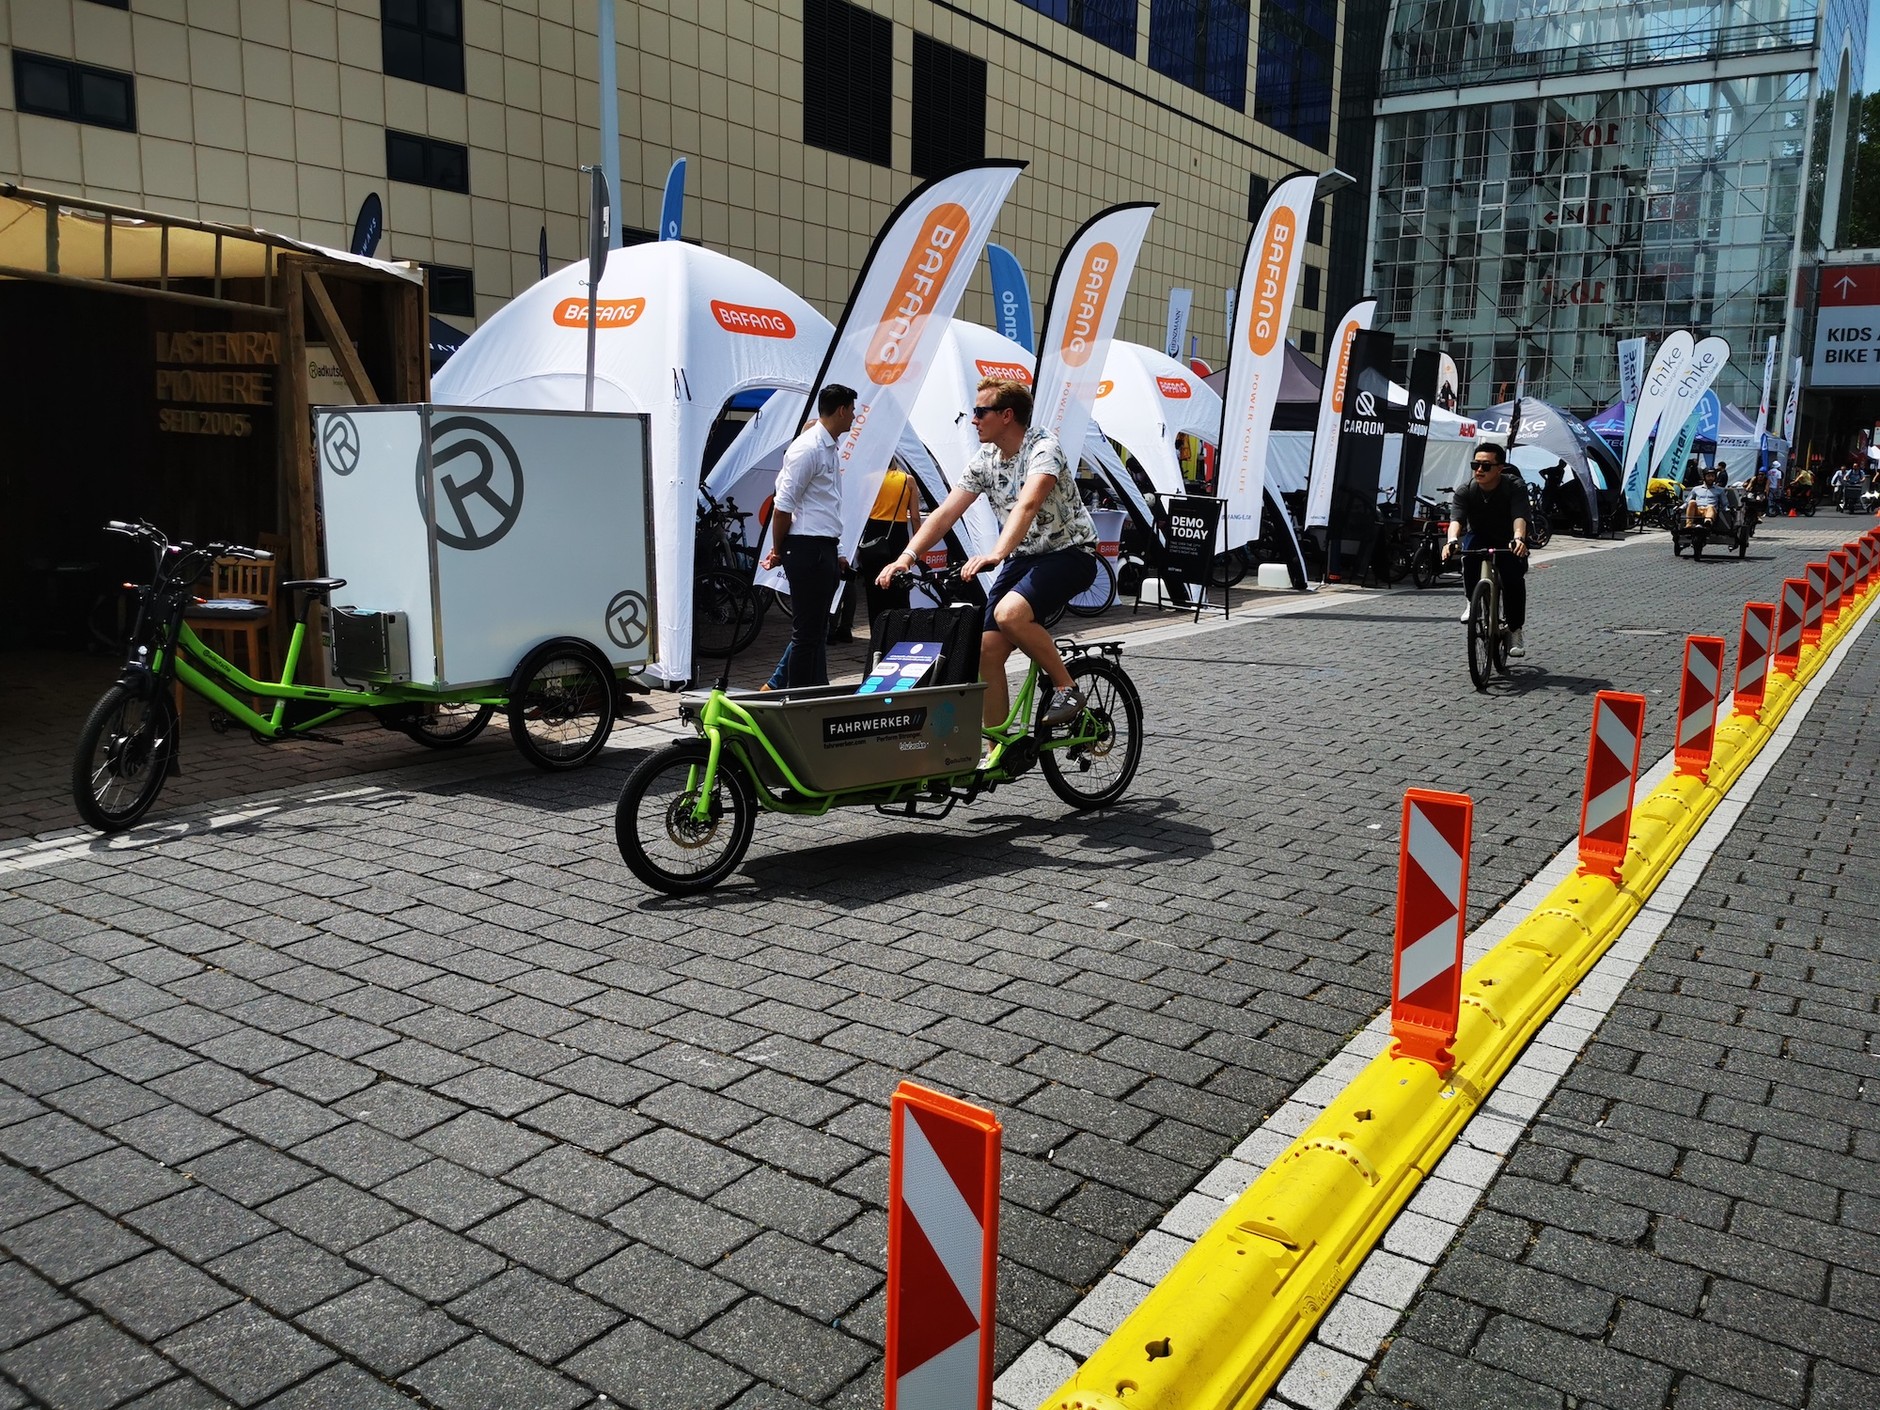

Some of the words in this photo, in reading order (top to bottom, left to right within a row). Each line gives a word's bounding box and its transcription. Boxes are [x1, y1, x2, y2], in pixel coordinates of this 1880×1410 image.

[880, 224, 957, 365] BAFANG
[1256, 224, 1289, 339] BAFANG
[564, 304, 637, 321] BAFANG
[718, 306, 786, 331] BAFANG
[1070, 255, 1110, 353] BAFANG
[156, 331, 281, 365] LASTENRA
[1827, 327, 1872, 342] KIDS
[1825, 349, 1868, 363] BIKE
[982, 364, 1026, 380] BAFANG
[1650, 347, 1682, 396] chike
[1678, 352, 1715, 397] chike
[156, 369, 273, 406] PIONIERE
[1248, 374, 1259, 420] POWER
[841, 403, 870, 461] POWER
[1343, 419, 1384, 436] CARQON
[1481, 418, 1547, 432] chke
[1242, 427, 1251, 462] YOUR
[1171, 515, 1204, 528] DEMO
[1171, 526, 1209, 540] TODAY
[830, 715, 910, 735] FAHRWERKER
